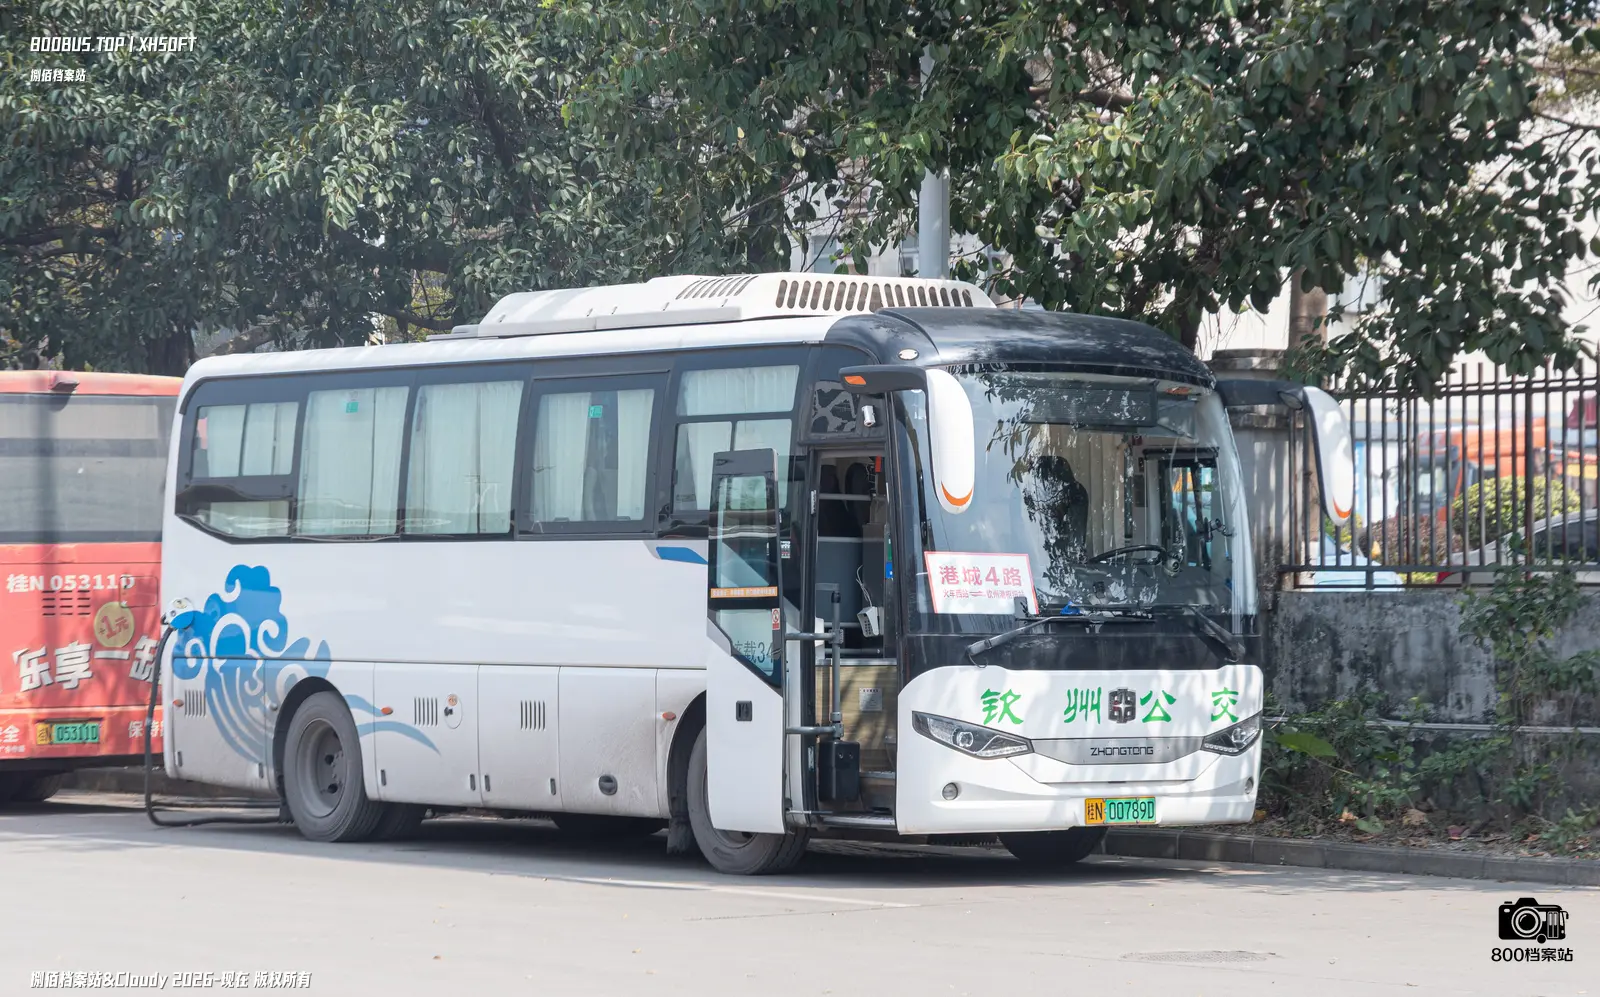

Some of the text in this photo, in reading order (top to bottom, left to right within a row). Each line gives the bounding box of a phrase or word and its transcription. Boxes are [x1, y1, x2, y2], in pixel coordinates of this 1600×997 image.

[6, 573, 44, 593] 桂N
[939, 565, 1022, 587] 港城4路
[1090, 747, 1154, 756] ZHONGTONG
[1109, 801, 1154, 820] 00789D
